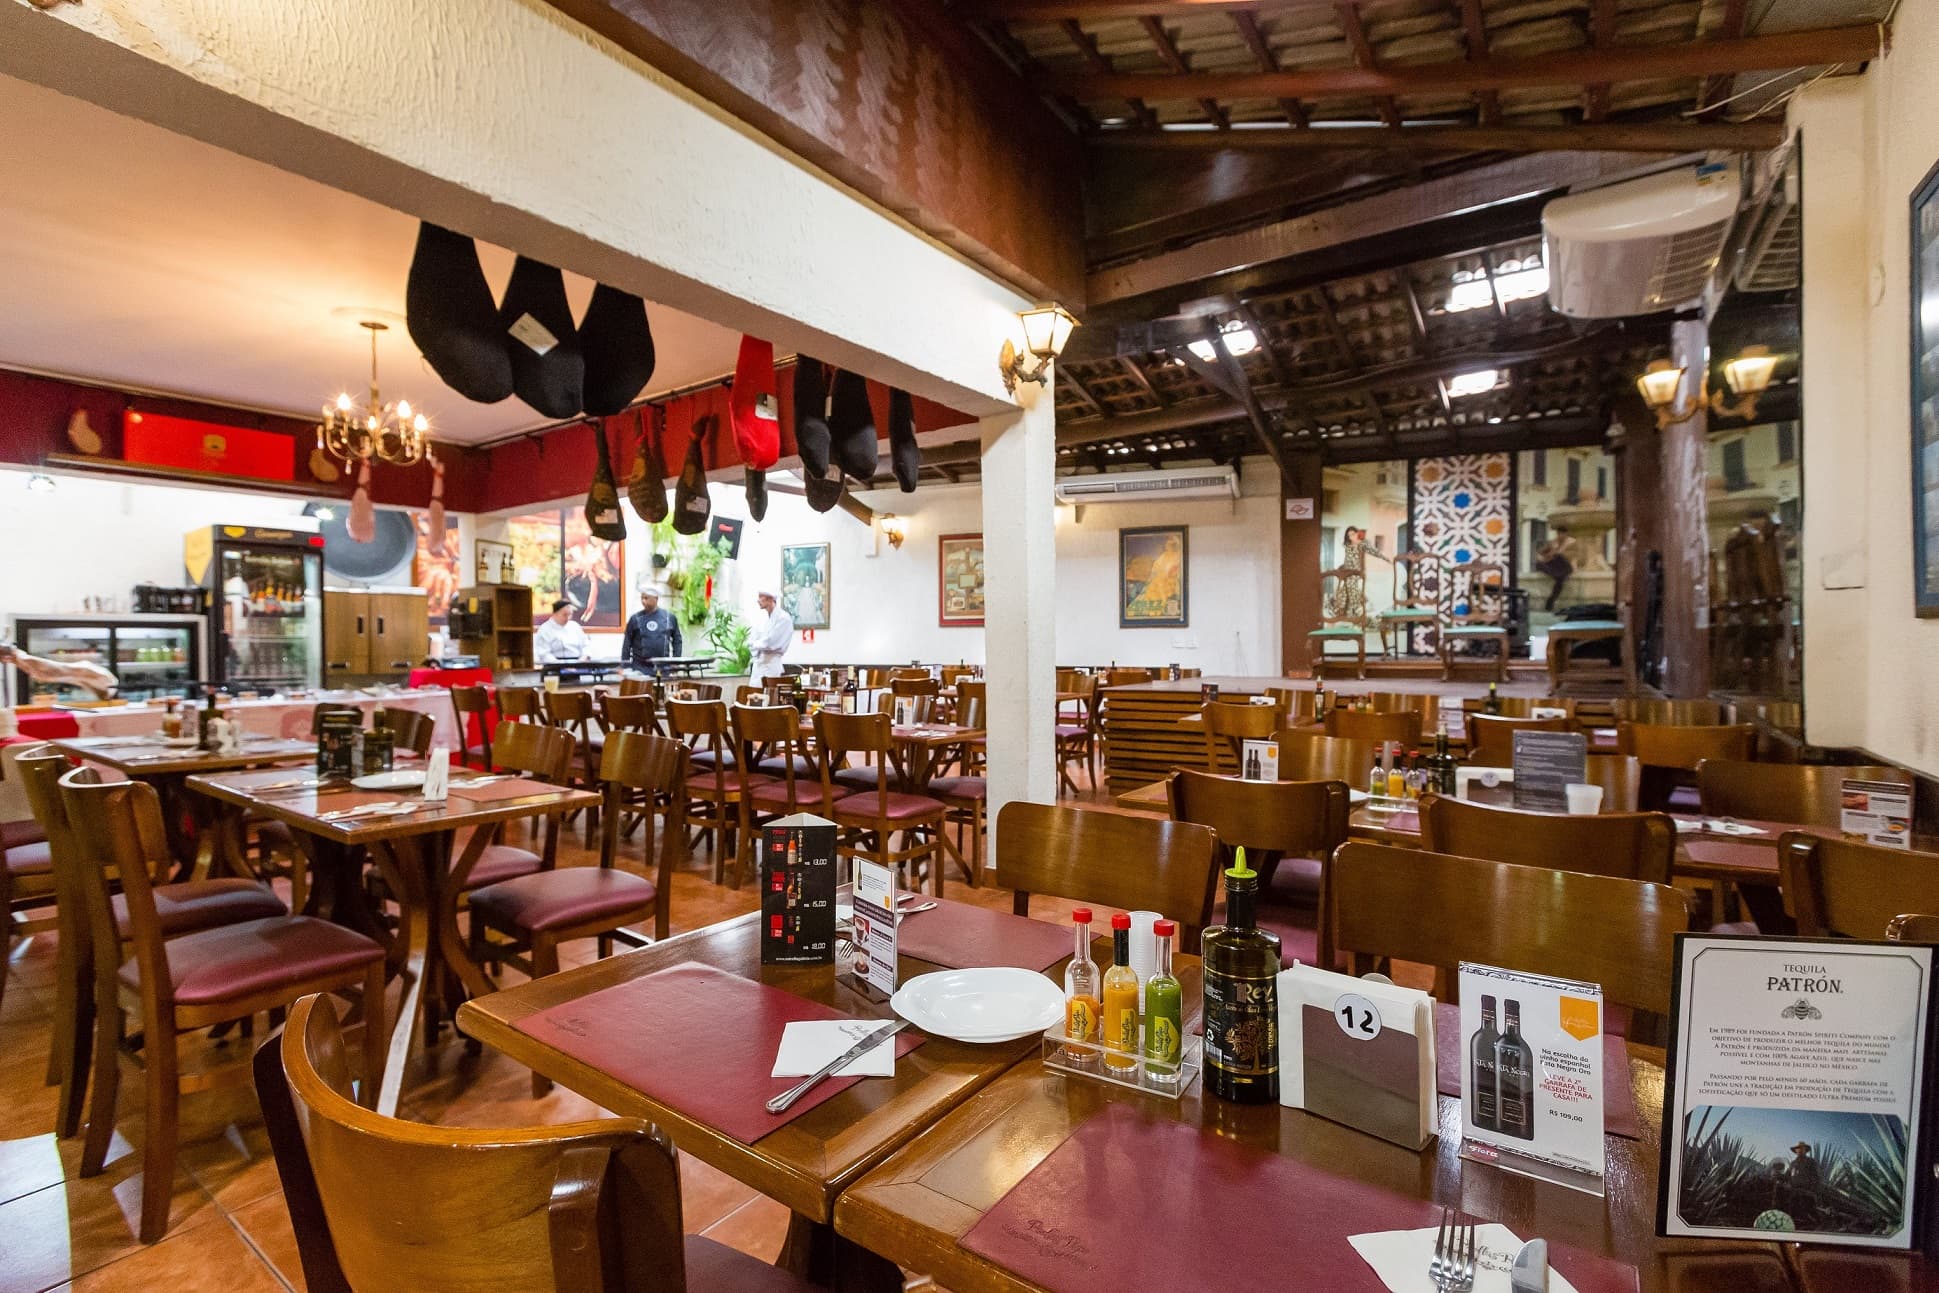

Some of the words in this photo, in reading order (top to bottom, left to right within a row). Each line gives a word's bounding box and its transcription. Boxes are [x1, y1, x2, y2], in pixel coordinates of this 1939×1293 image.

[1784, 964, 1826, 974] TEQUILA
[1342, 1006, 1374, 1034] 12
[1560, 1059, 1591, 1069] espanhol
[1544, 1079, 1576, 1090] GARRAFA
[1539, 1083, 1573, 1095] PRESENTE
[1575, 1091, 1593, 1100] PARA
[1559, 1112, 1583, 1122] 109,00
